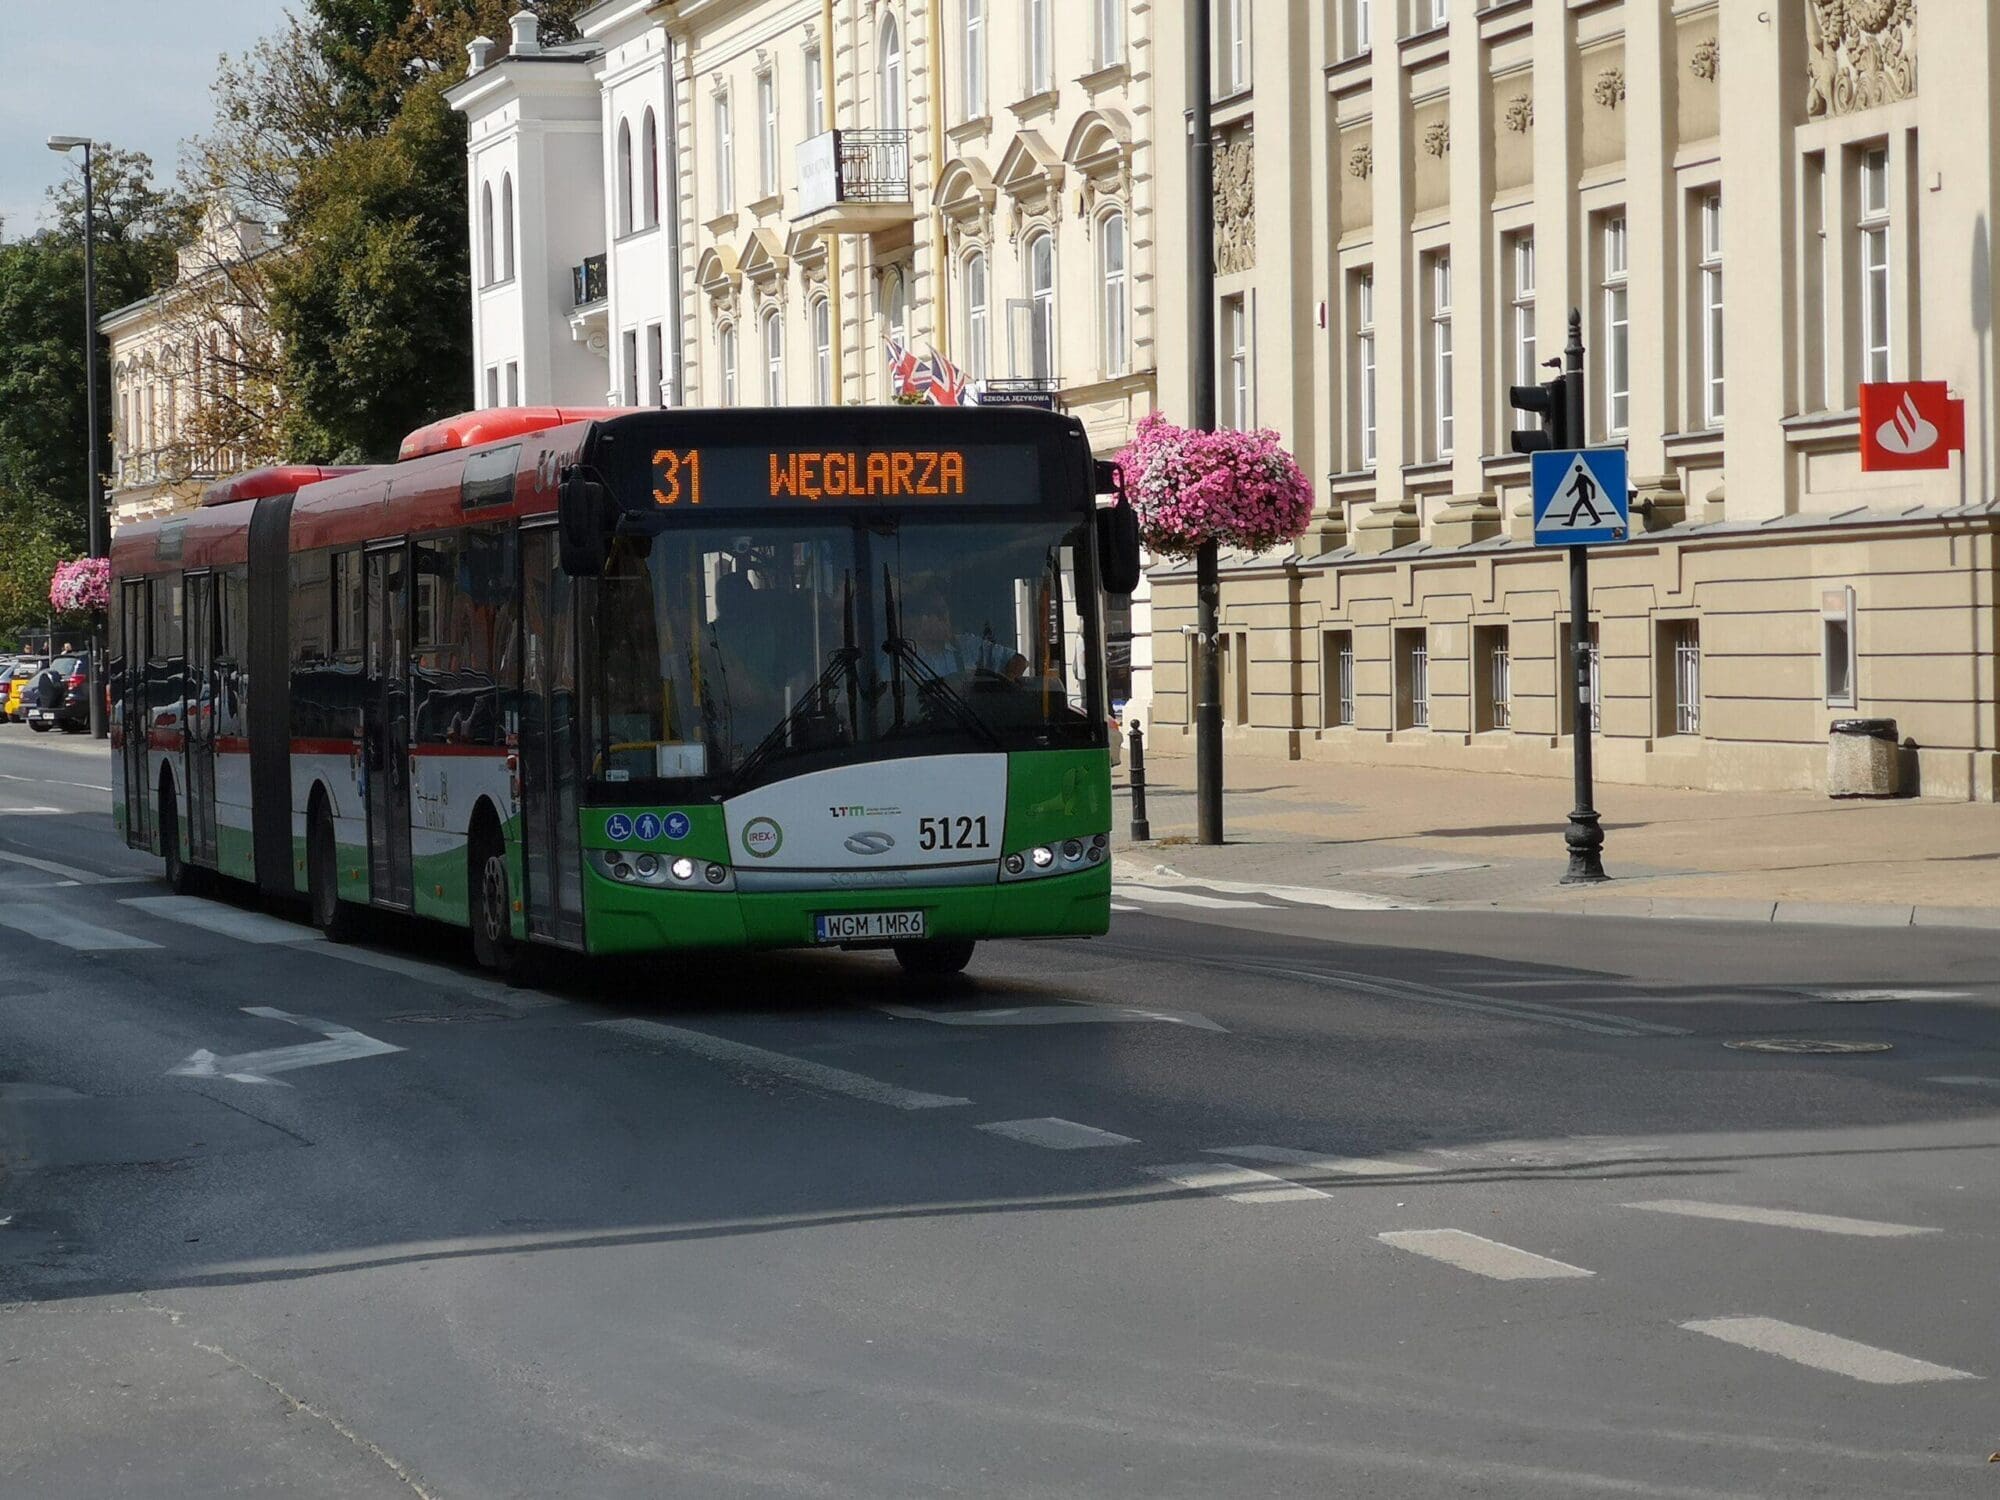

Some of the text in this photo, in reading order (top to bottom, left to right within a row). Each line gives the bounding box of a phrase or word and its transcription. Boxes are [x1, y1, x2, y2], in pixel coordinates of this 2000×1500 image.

[652, 449, 963, 504] 31 WĘGLARZA
[919, 816, 989, 850] 5121
[828, 914, 920, 936] WGM 1MR6
